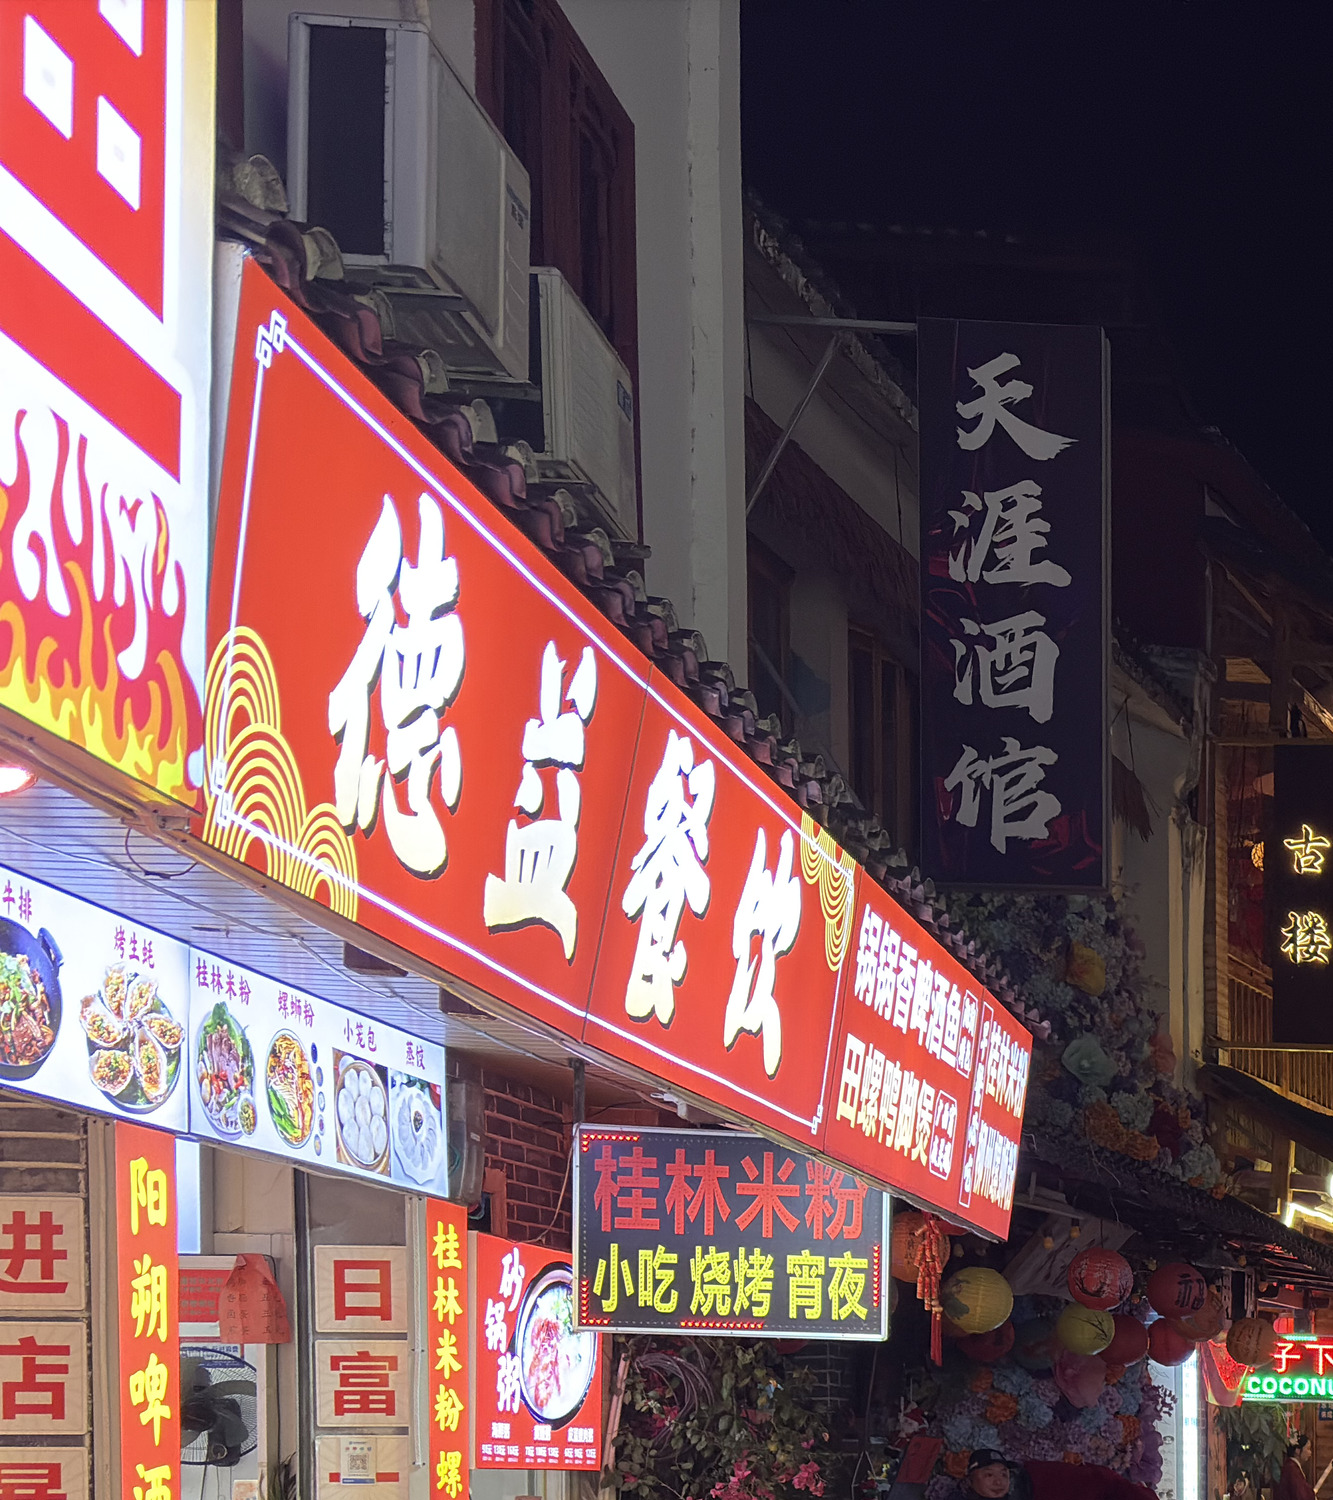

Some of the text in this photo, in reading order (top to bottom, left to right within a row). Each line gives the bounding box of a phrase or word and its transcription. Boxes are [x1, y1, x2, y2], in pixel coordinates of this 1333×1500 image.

[945, 352, 1079, 854] 天涯酒馆
[328, 492, 800, 1077] 德益餐饮
[114, 926, 155, 969] 烤生蚝
[1282, 823, 1332, 964] 古楼
[196, 960, 250, 1006] 桂林米粉
[344, 1018, 377, 1053] 小笼包
[855, 903, 962, 1068] 锅锅香啤酒鱼
[836, 1032, 936, 1167] 田螺鸭脚煲
[985, 1020, 1029, 1119] 桂林米粉
[594, 1145, 868, 1240] 桂林米粉
[431, 1221, 466, 1432] 桂林米粉
[485, 1247, 525, 1414] 砂锅粥
[593, 1243, 868, 1320] 小吃 烧烤 宵夜
